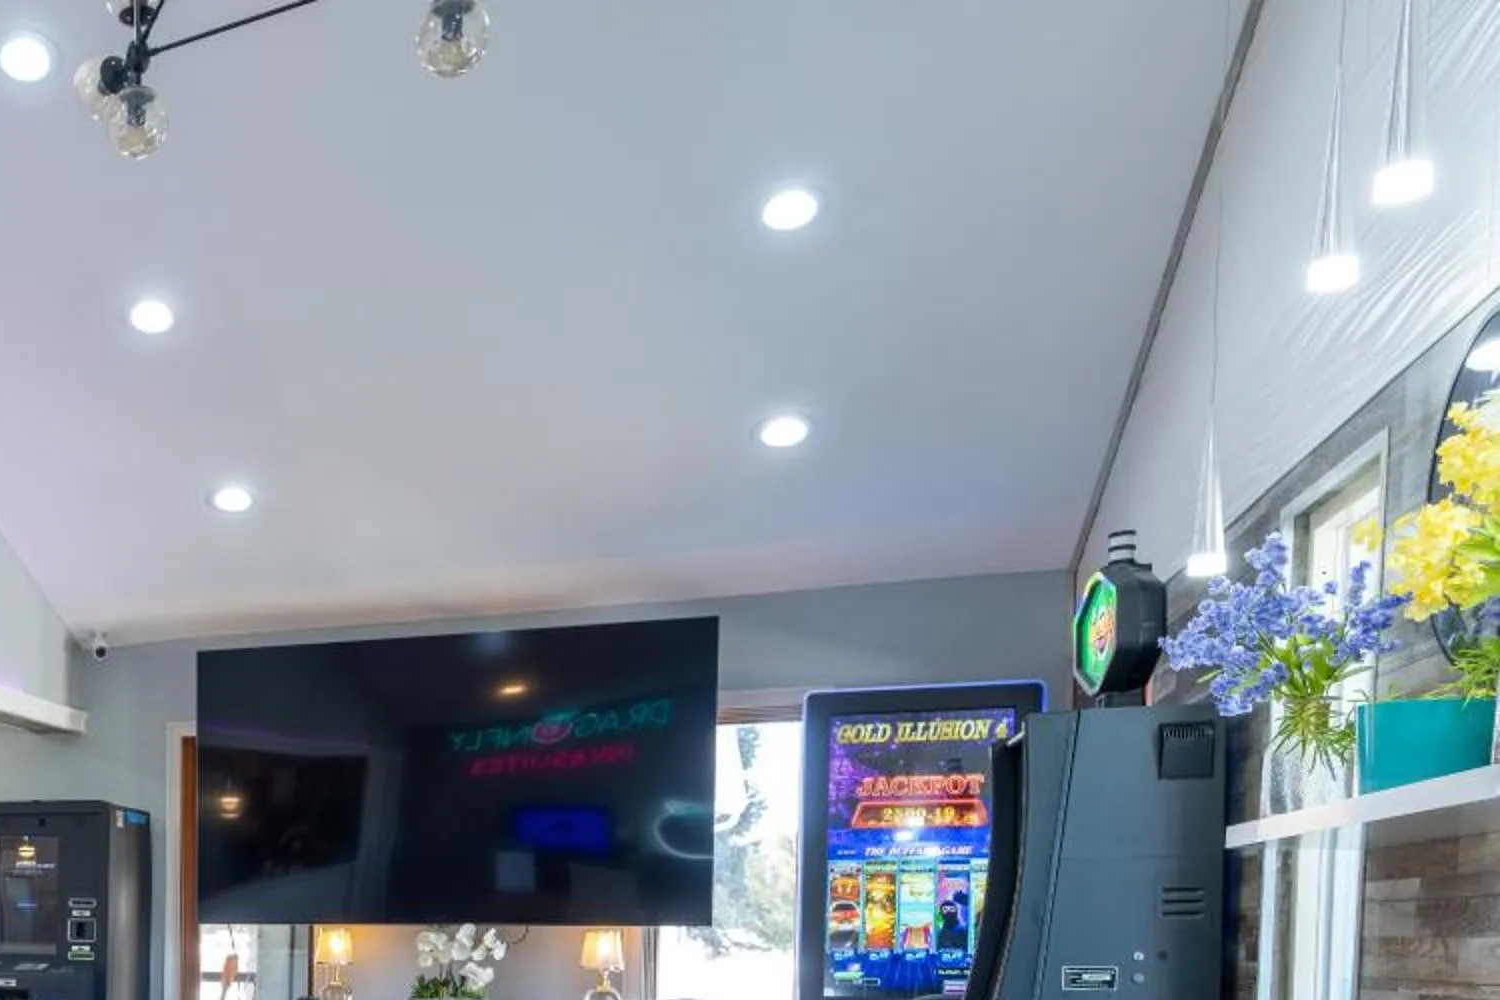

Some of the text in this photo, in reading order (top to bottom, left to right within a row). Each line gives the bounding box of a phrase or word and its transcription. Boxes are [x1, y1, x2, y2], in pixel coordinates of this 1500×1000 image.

[836, 722, 892, 744] GOLD
[895, 718, 993, 743] ILLUSION
[856, 774, 985, 797] JACKPOT
